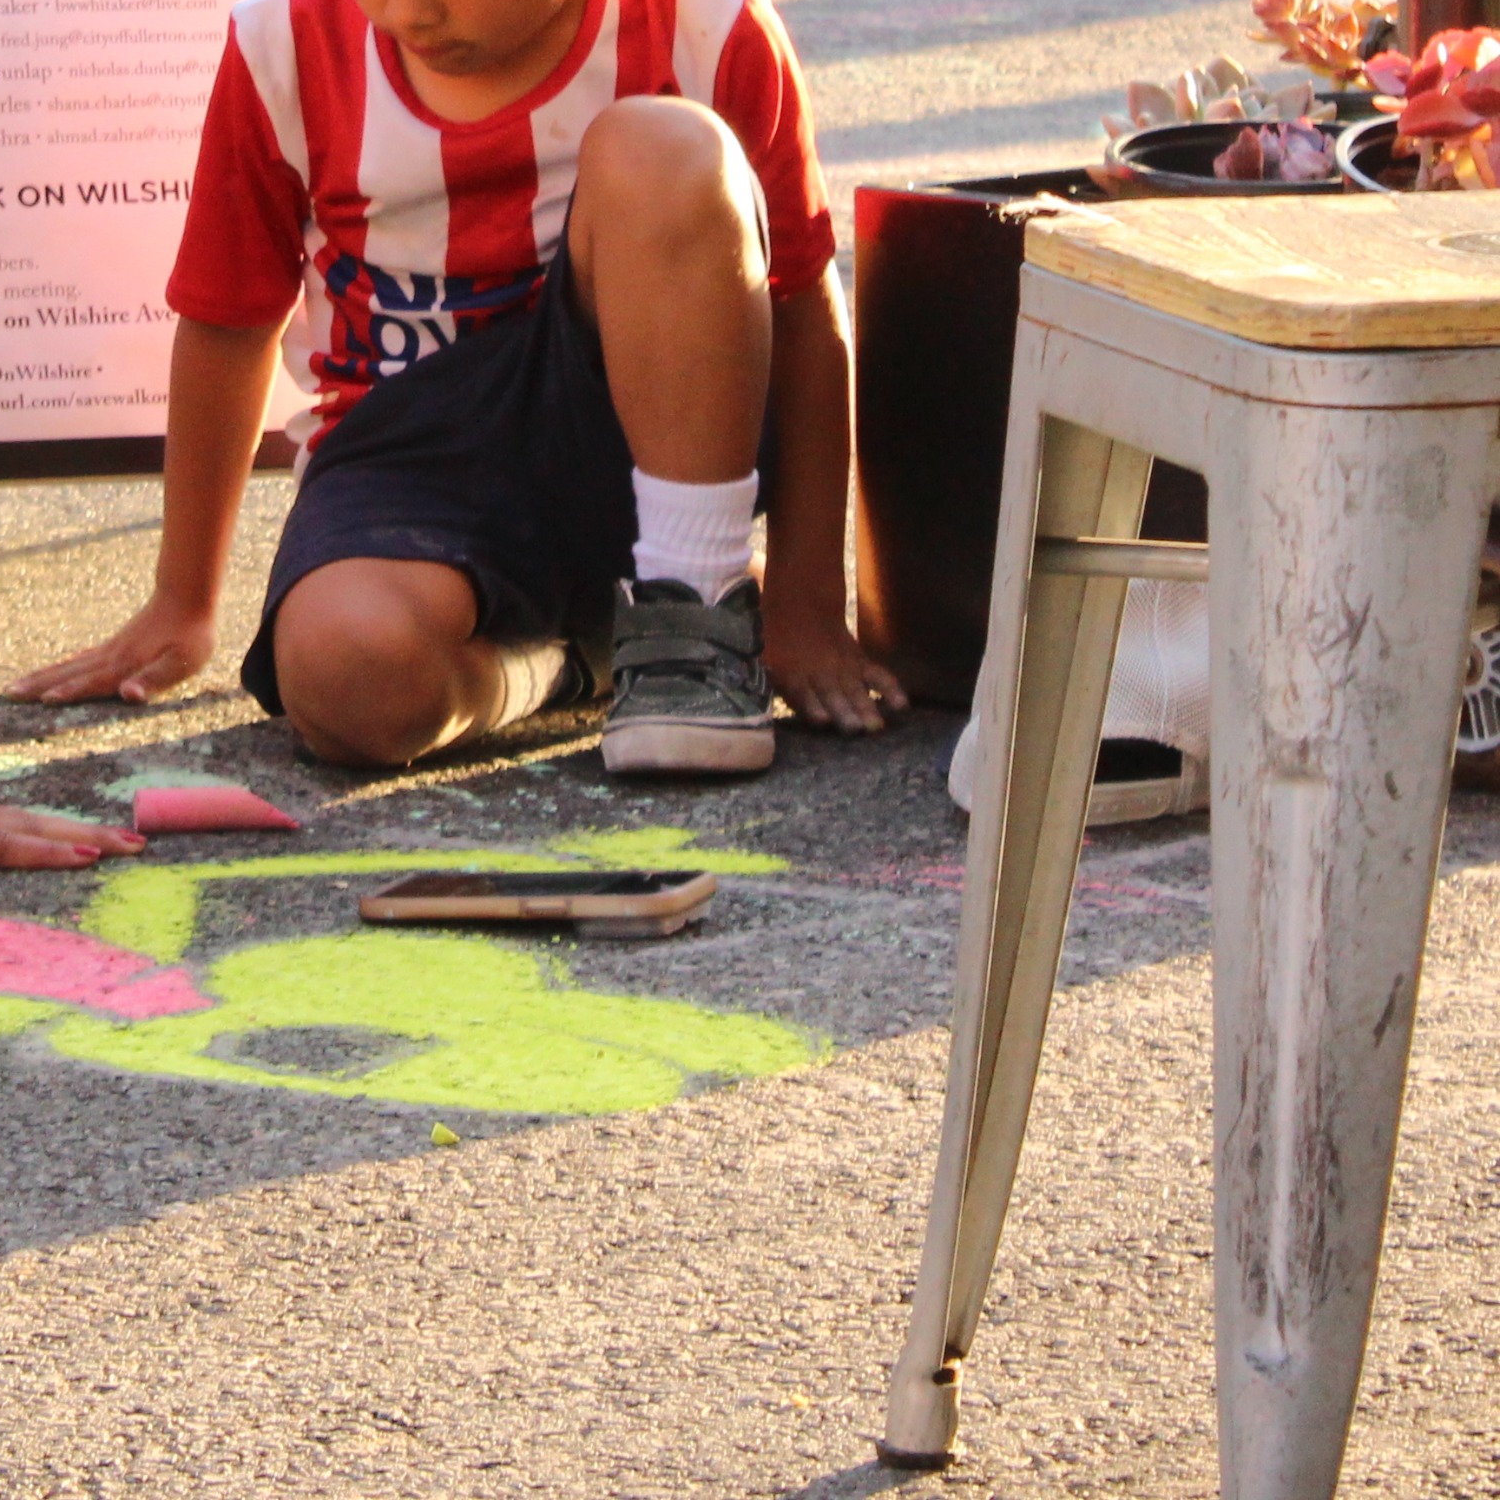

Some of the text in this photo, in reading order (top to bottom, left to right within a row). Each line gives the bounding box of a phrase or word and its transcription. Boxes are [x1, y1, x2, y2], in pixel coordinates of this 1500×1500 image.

[18, 184, 66, 208] ON
[3, 281, 82, 302] meeting.
[4, 316, 30, 328] on
[37, 305, 130, 327] Wilshire
